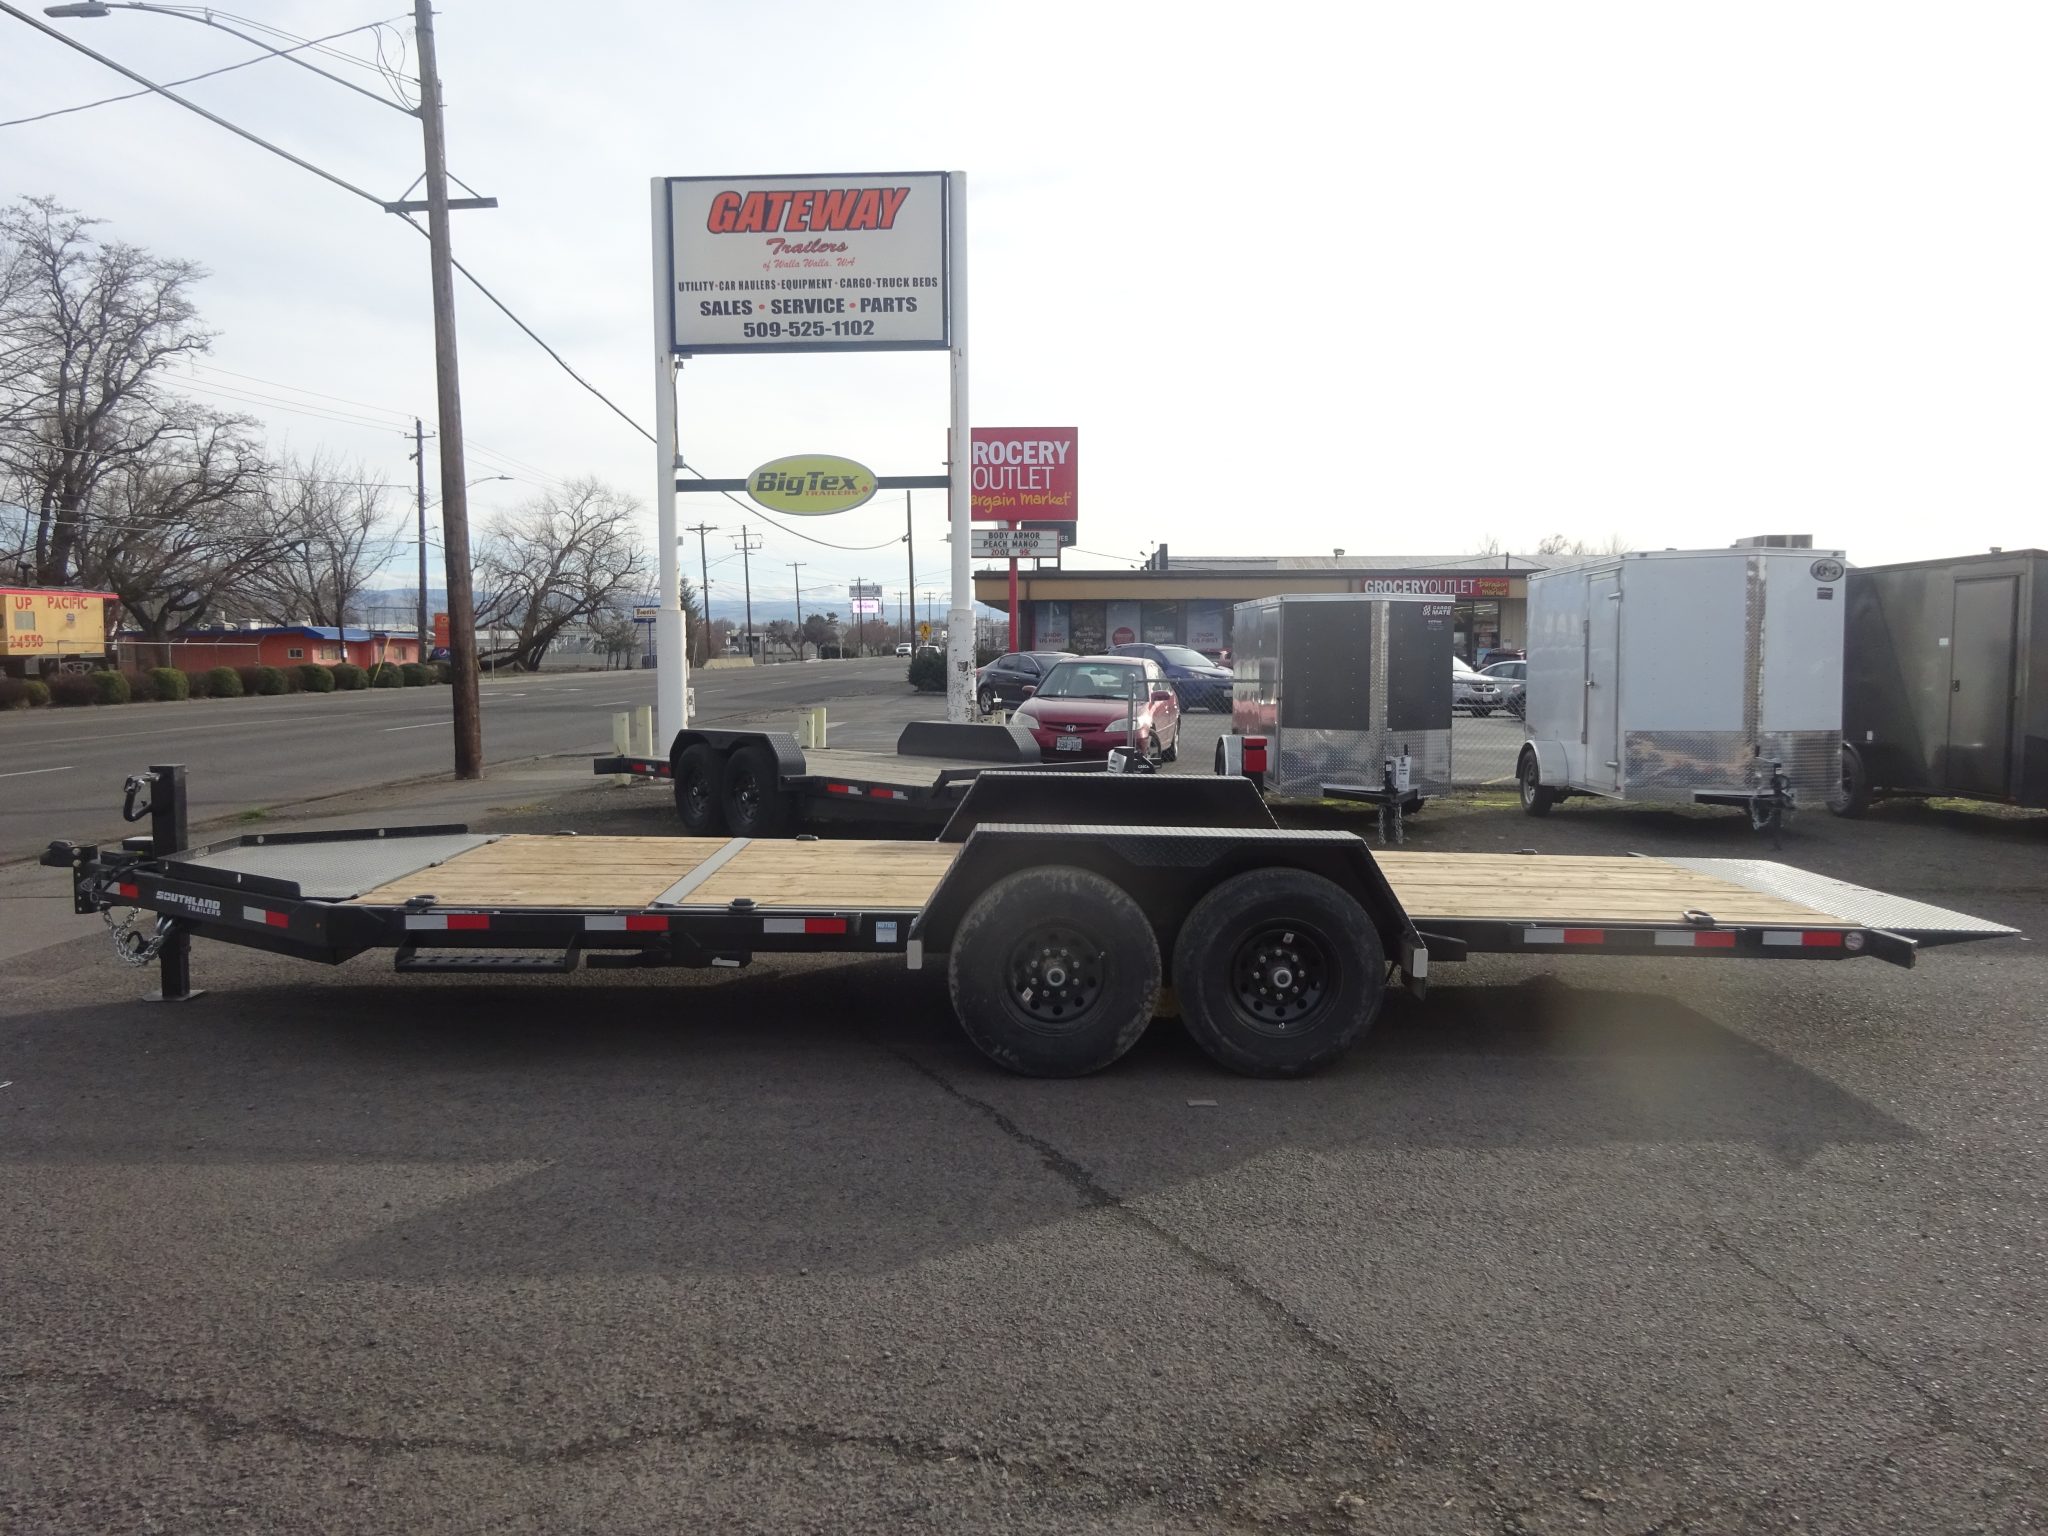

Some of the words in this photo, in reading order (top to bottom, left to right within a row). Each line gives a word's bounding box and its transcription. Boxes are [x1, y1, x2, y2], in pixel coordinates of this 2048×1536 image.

[707, 187, 911, 234] GATEWAY
[766, 238, 848, 255] Trailers
[763, 260, 771, 271] of
[774, 259, 800, 269] Walla
[836, 257, 855, 267] WA
[678, 281, 714, 292] UTILITY
[719, 281, 736, 291] CAR
[739, 279, 776, 291] HAULERS
[781, 279, 832, 290] EQUIPMENT
[840, 278, 872, 288] CARGO
[876, 277, 910, 288] TRUCK
[912, 277, 938, 288] BEDS
[700, 300, 753, 316] SALES
[771, 298, 845, 315] SERVICE
[860, 297, 918, 313] PARTS
[743, 320, 875, 338] 509-525-1102
[972, 440, 1071, 465] ROCERY
[972, 466, 1055, 490] OUTLET
[971, 492, 1016, 513] argain
[983, 540, 1008, 548] PEACH
[1012, 540, 1039, 548] MANGO
[988, 532, 1009, 540] BODY
[1014, 532, 1040, 540] ARMOR
[15, 597, 32, 609] UP
[47, 596, 88, 609] PACIFIC
[9, 634, 44, 648] 24550
[156, 890, 221, 910] SOUTHLAND
[187, 905, 221, 916] TRAILERS
